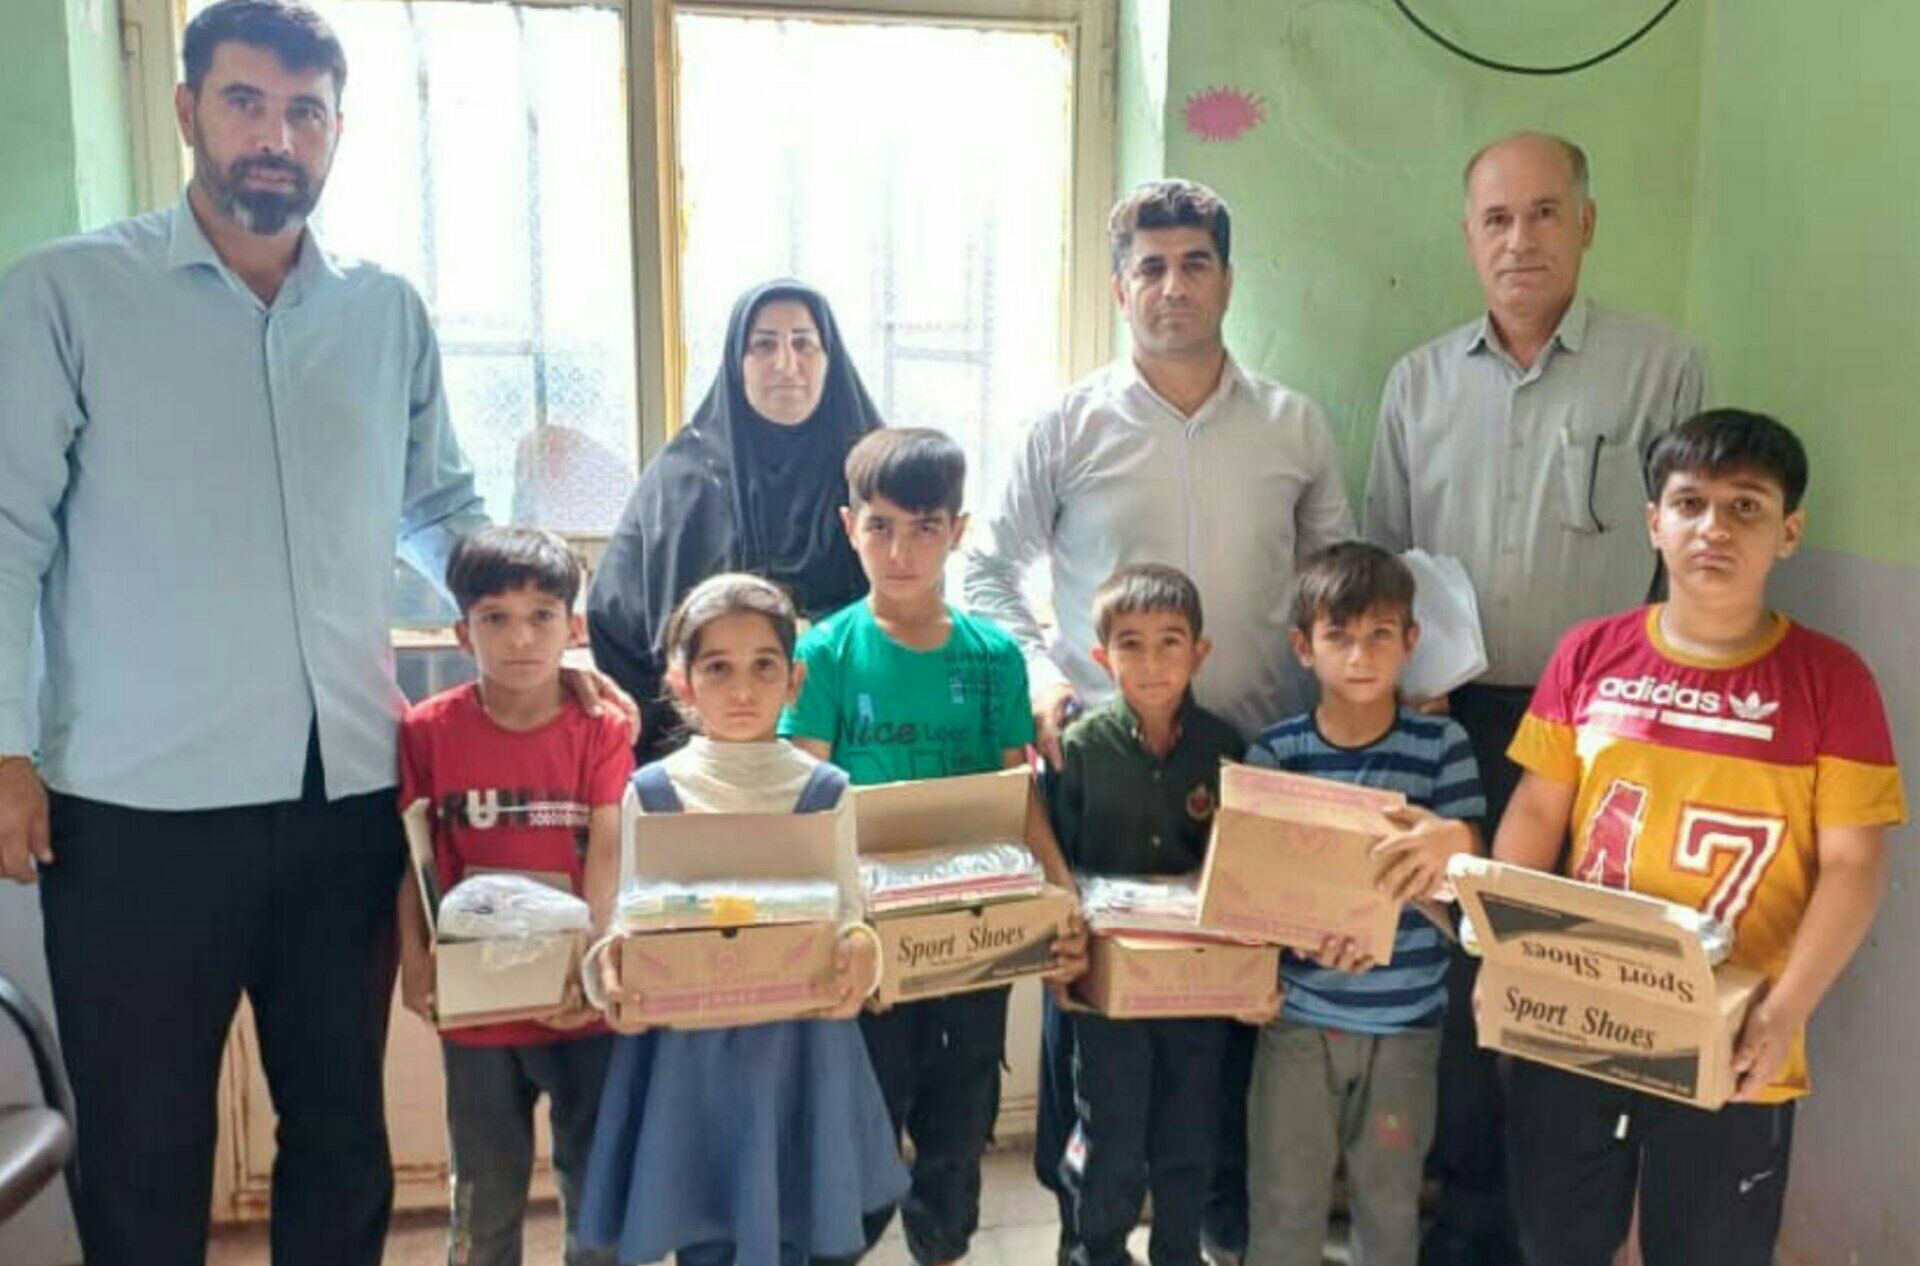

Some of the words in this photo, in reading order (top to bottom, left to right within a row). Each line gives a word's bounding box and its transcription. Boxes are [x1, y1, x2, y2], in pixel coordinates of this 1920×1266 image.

[1600, 676, 1720, 713] adidas
[897, 933, 955, 967] Sport
[966, 918, 1025, 949] Shoes
[1521, 940, 1600, 979] Shoes
[1619, 964, 1694, 1003] Sport
[1505, 986, 1567, 1026] Sport
[1581, 1006, 1656, 1050] Shoes
